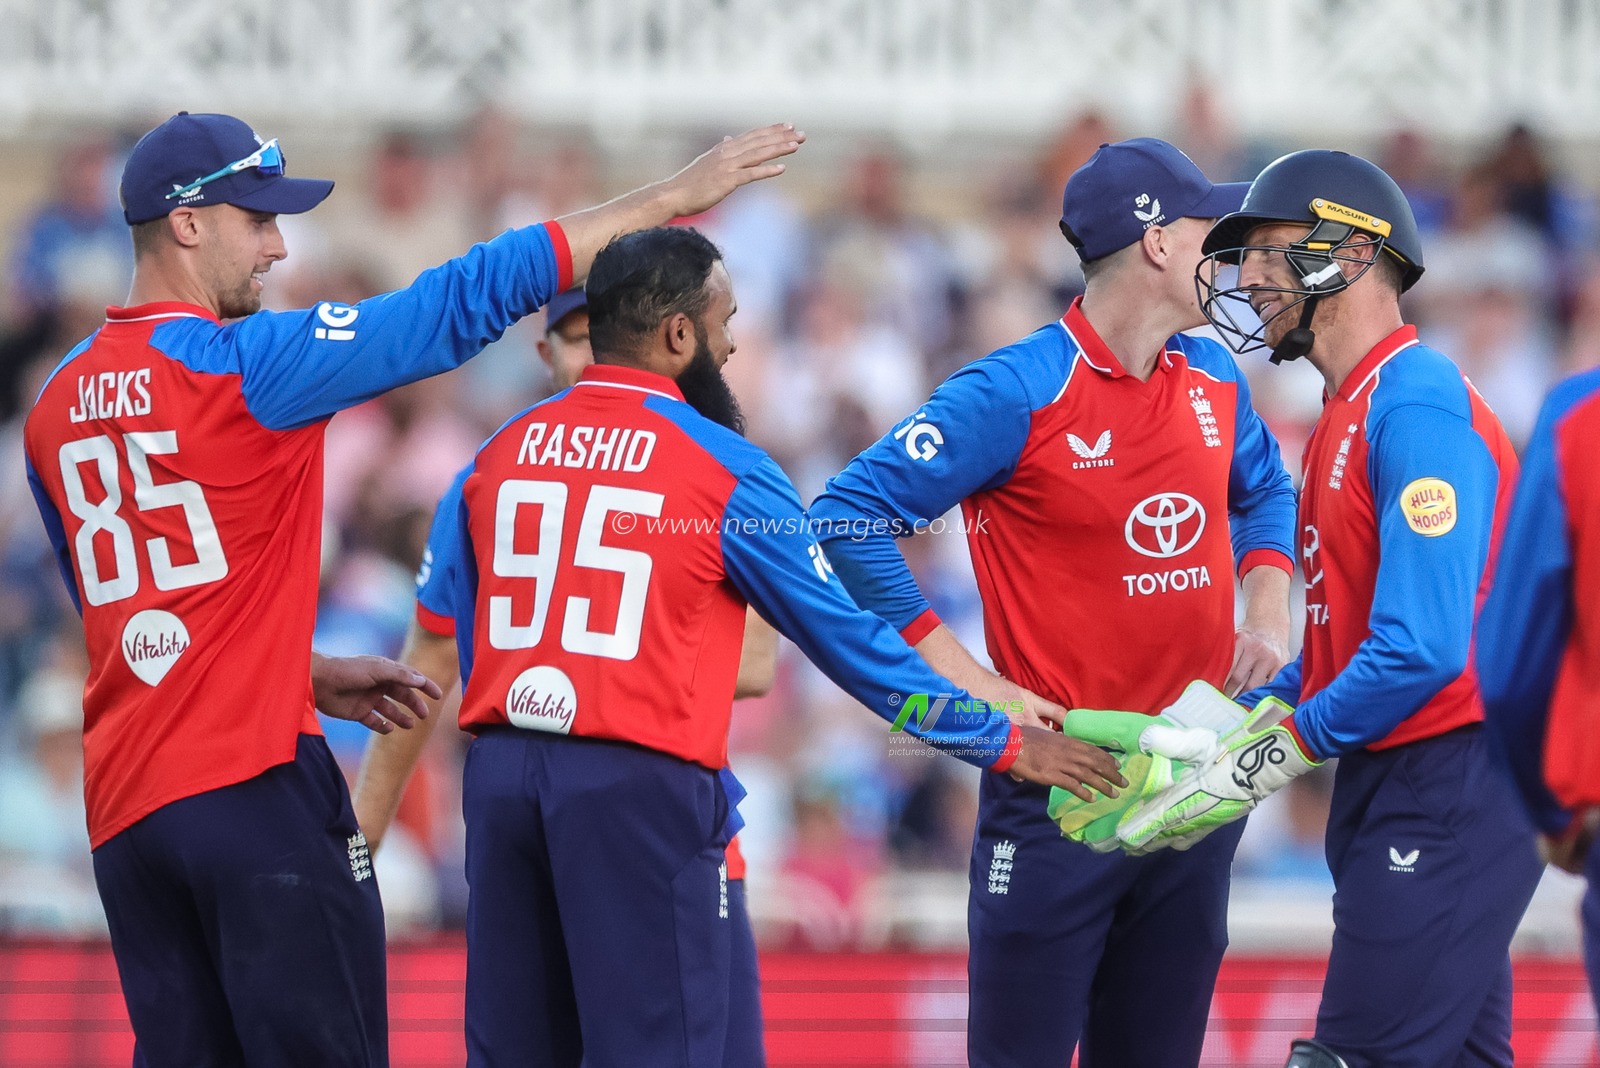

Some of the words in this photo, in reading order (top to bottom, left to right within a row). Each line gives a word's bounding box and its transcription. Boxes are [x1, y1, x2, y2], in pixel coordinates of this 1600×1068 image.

[1134, 193, 1151, 208] 50
[1326, 204, 1369, 223] MASURI
[69, 367, 152, 424] JACKS
[516, 421, 657, 473] RASHID
[1072, 458, 1115, 470] CASTORE
[1410, 488, 1446, 509] HULA
[58, 429, 229, 607] 85
[1411, 505, 1453, 529] HOOPS
[488, 478, 666, 661] 95
[1122, 565, 1212, 597] TOYOTA
[124, 631, 188, 663] Vitality
[510, 684, 573, 730] Vitality
